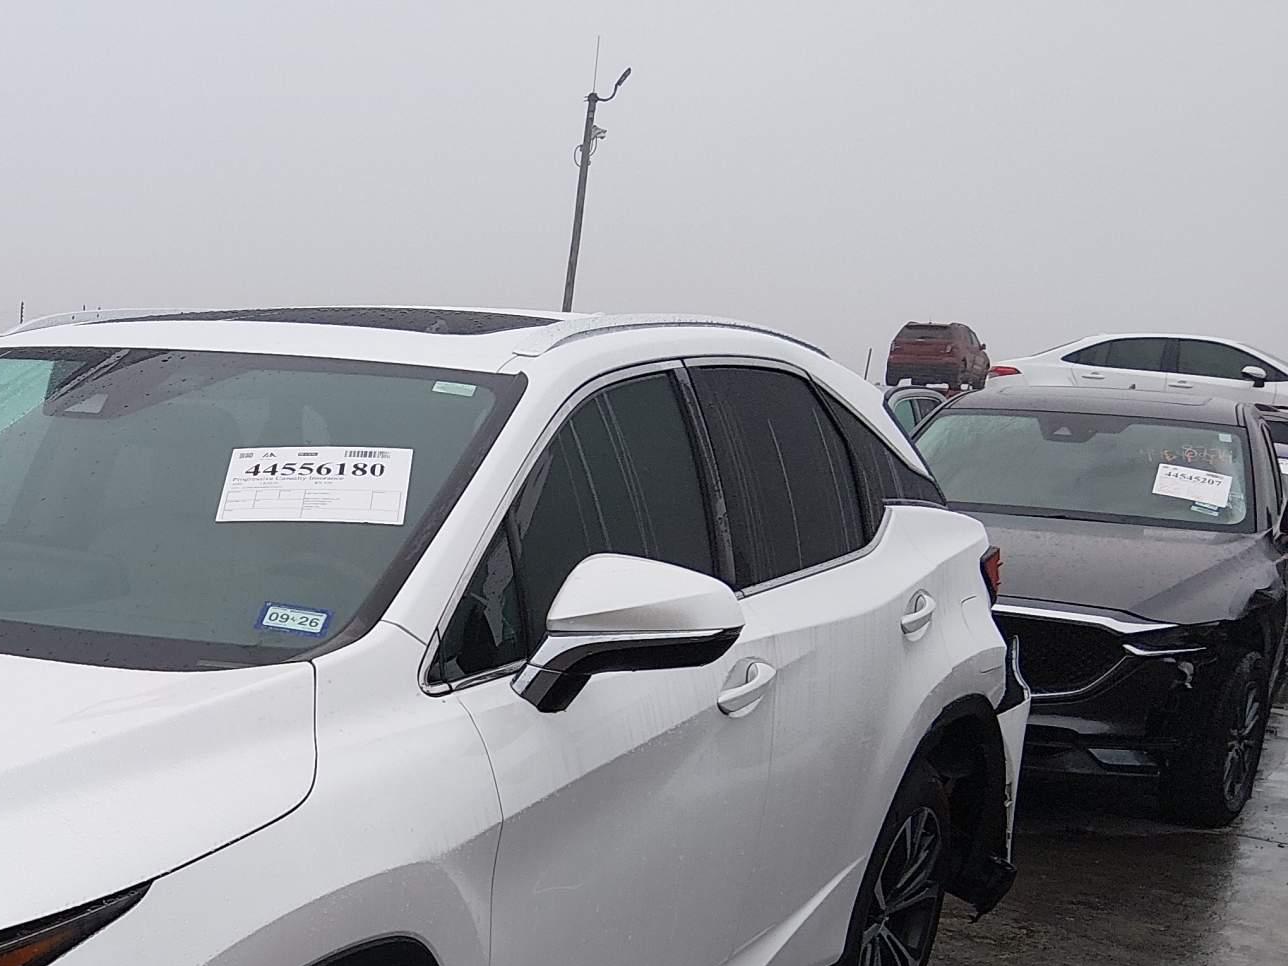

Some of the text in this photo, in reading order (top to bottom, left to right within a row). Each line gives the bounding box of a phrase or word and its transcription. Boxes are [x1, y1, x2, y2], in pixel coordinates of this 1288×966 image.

[245, 462, 385, 477] 44556180
[1166, 471, 1222, 486] 44545207
[268, 612, 321, 628] 09 26
